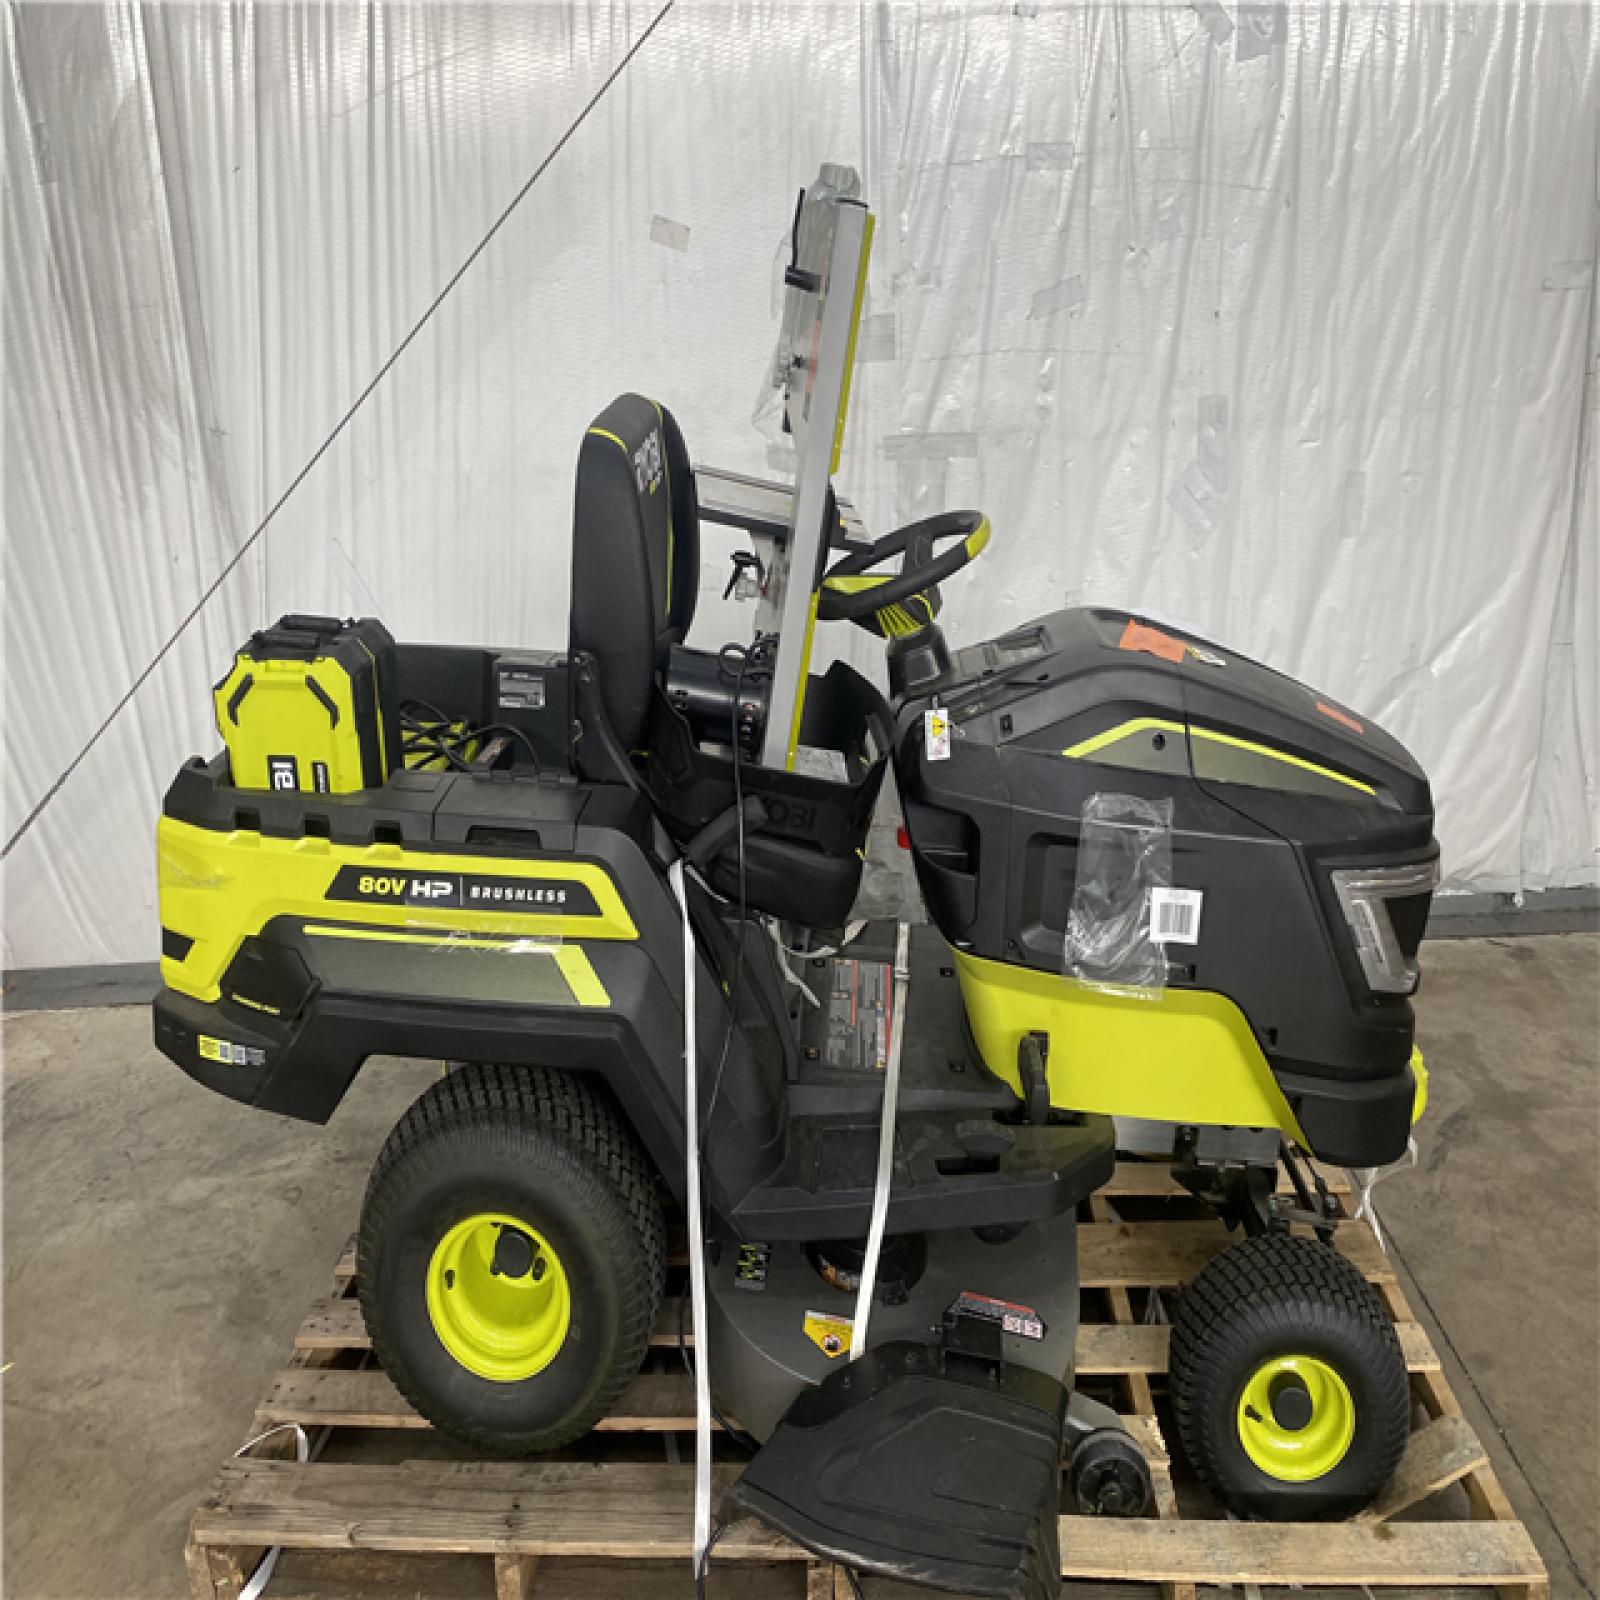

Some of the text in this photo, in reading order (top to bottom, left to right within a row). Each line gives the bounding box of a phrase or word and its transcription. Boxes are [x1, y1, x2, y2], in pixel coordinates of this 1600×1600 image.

[358, 875, 566, 904] 80V HP BRUSHLESS
